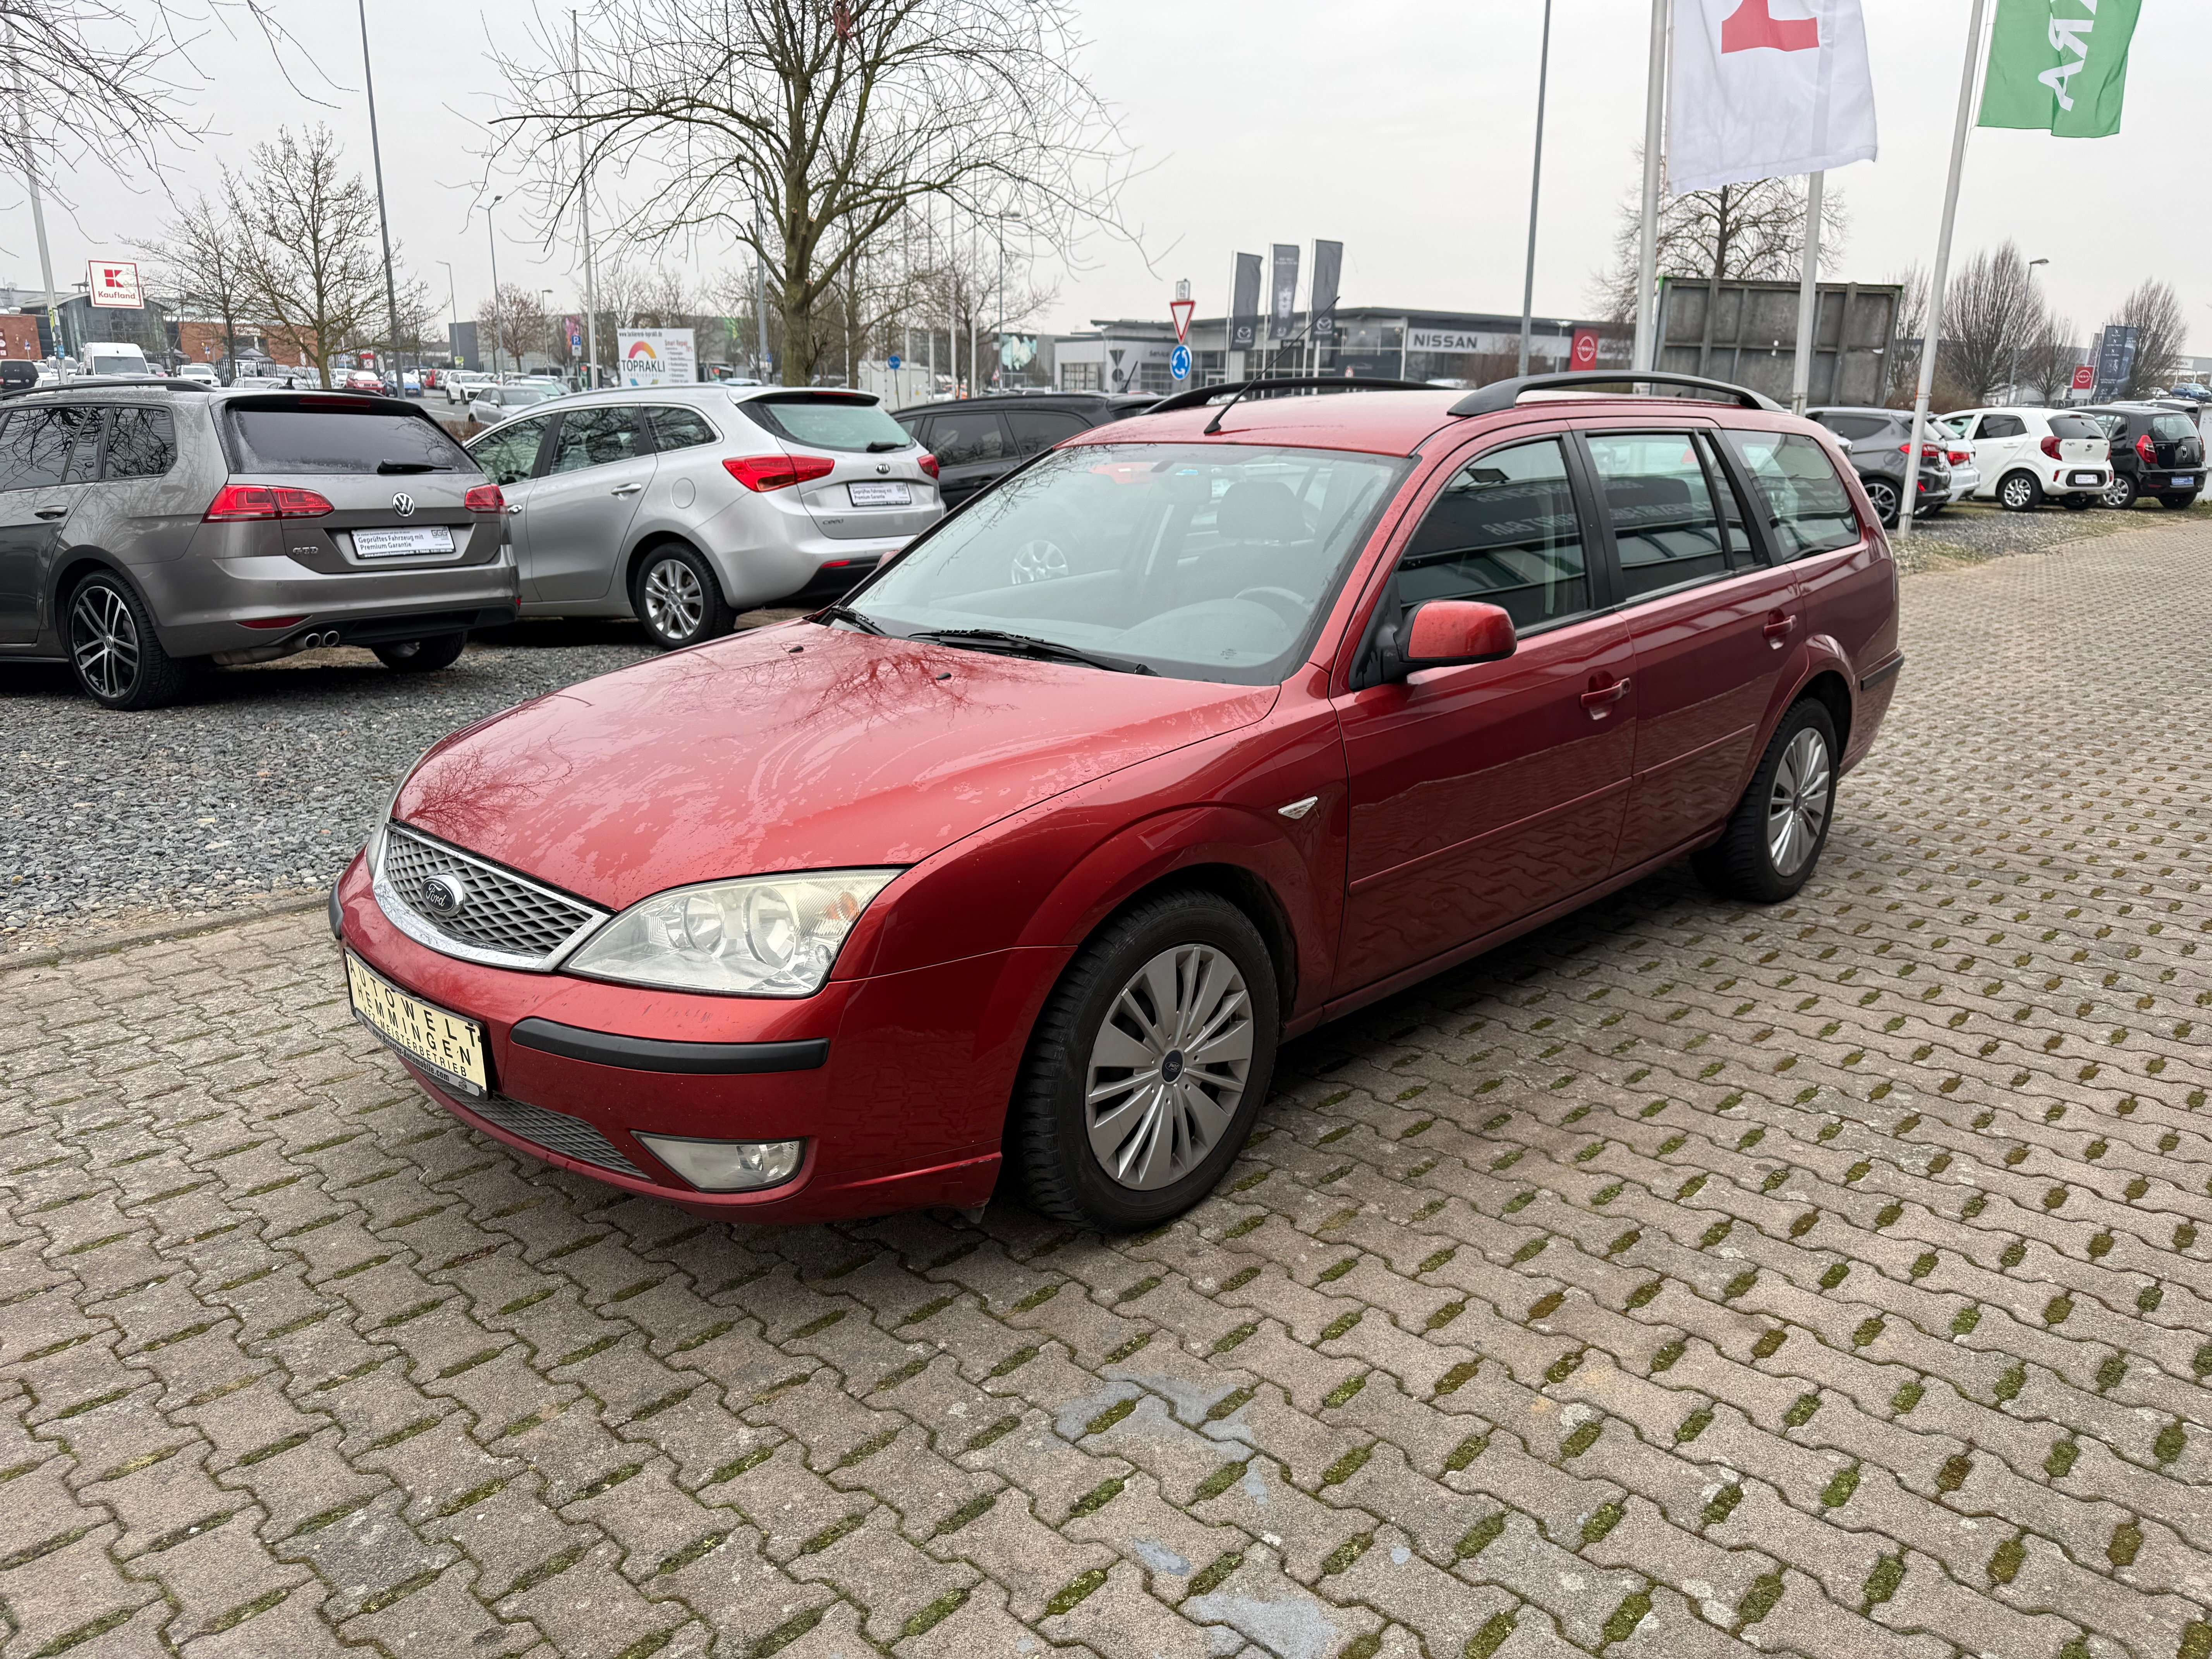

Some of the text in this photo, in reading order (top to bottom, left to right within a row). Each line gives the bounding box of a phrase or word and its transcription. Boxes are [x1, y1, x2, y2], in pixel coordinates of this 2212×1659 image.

[1414, 334, 1477, 348] NISSAN
[622, 360, 665, 372] TOPRAKLI
[358, 535, 388, 544] Geprüftes
[426, 883, 447, 907] Ford
[349, 957, 476, 1047] AUTOWELT
[357, 982, 471, 1066] HEMMINGEN
[364, 1005, 467, 1077] KFZ-MEISTERBETRIEB
[372, 1027, 450, 1082] www.Brinster-Automobile.com
